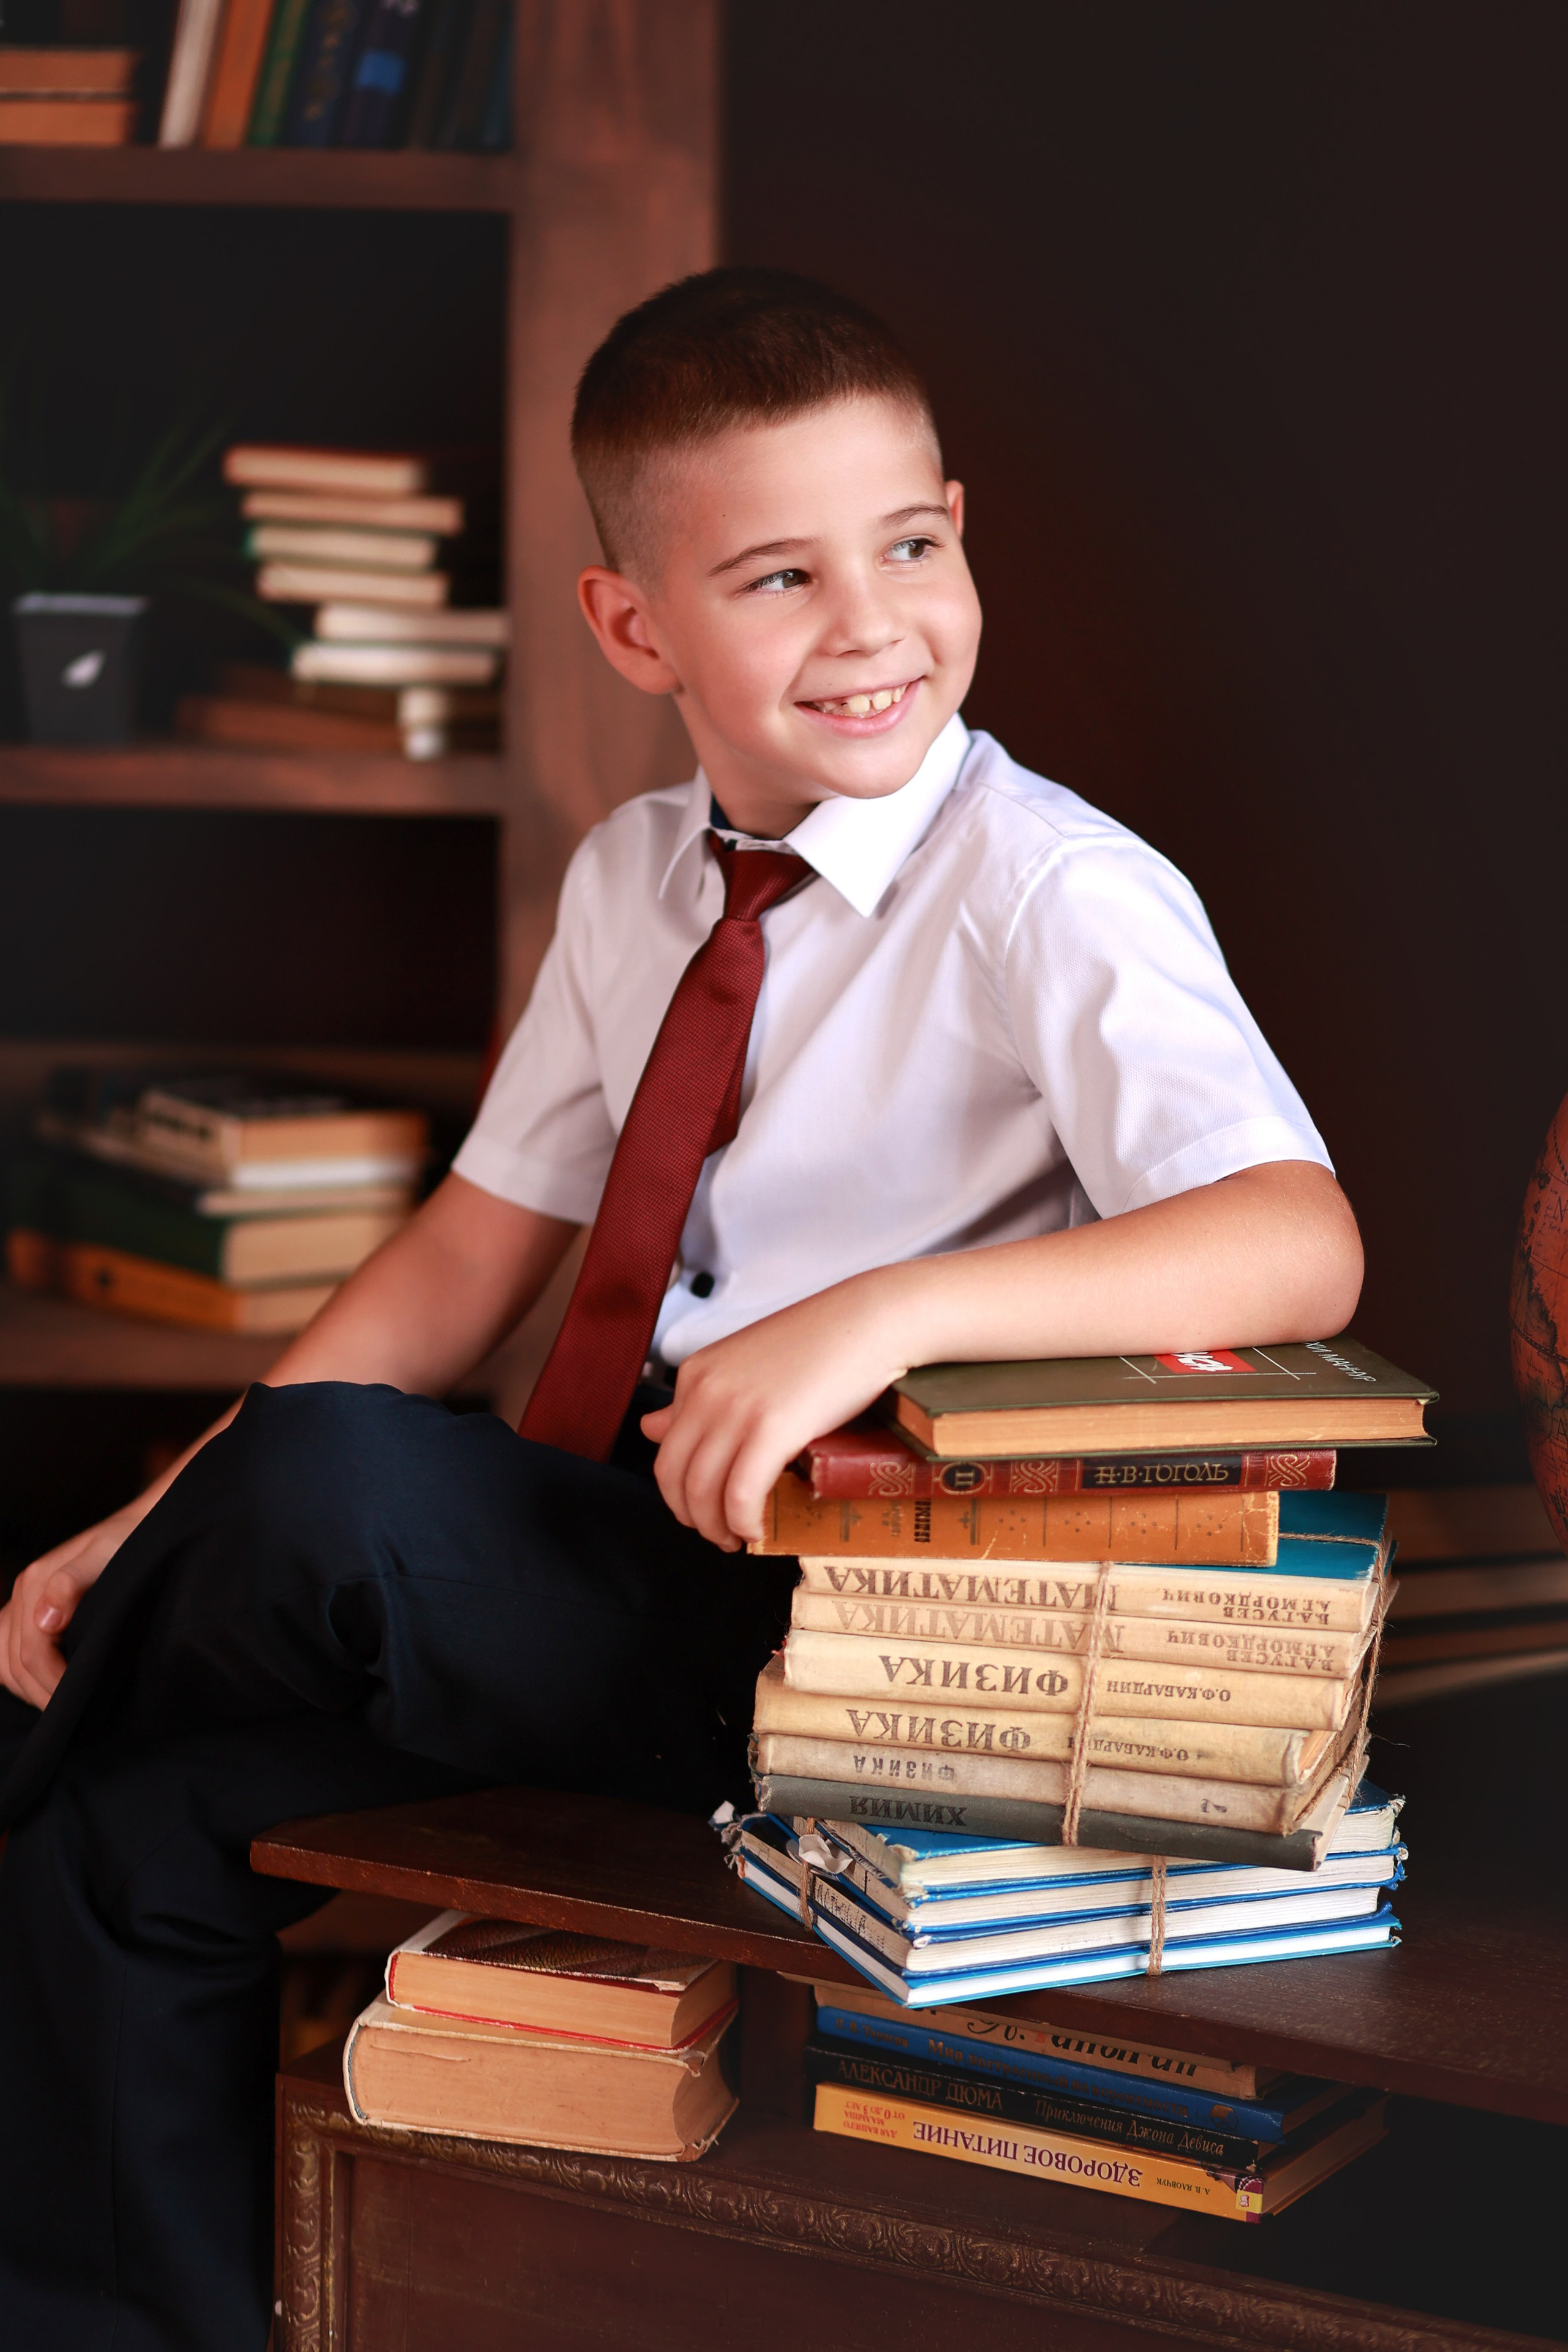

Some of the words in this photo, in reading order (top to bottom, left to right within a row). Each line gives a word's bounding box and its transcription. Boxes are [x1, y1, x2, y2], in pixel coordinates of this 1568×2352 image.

[824, 1566, 1119, 1611] МАТЕМАТИКА
[832, 1600, 1125, 1653] МАТЕМАТИКА
[879, 1655, 1068, 1696] ФИЗИКА
[845, 1709, 1031, 1752] ФИЗИКА
[854, 1755, 955, 1781] ФИЗИКА
[850, 1795, 967, 1826] ХИМИЯ
[862, 2024, 909, 2048] Тарасов
[836, 2060, 941, 2097] АЛЕКСАНДР
[946, 2084, 1003, 2111] ДЮМА
[1091, 2084, 1188, 2118] вероятности
[880, 2129, 897, 2138] ДЛЯ
[913, 2121, 1018, 2161] ПИТАНИЕ
[1035, 2099, 1123, 2132] Приключения
[1126, 2120, 1175, 2145] Джона
[1178, 2131, 1224, 2156] Девиса
[1023, 2145, 1143, 2187] ЗДОРОВОЕ
[1156, 2177, 1193, 2192] ЯЛОВЧУК
